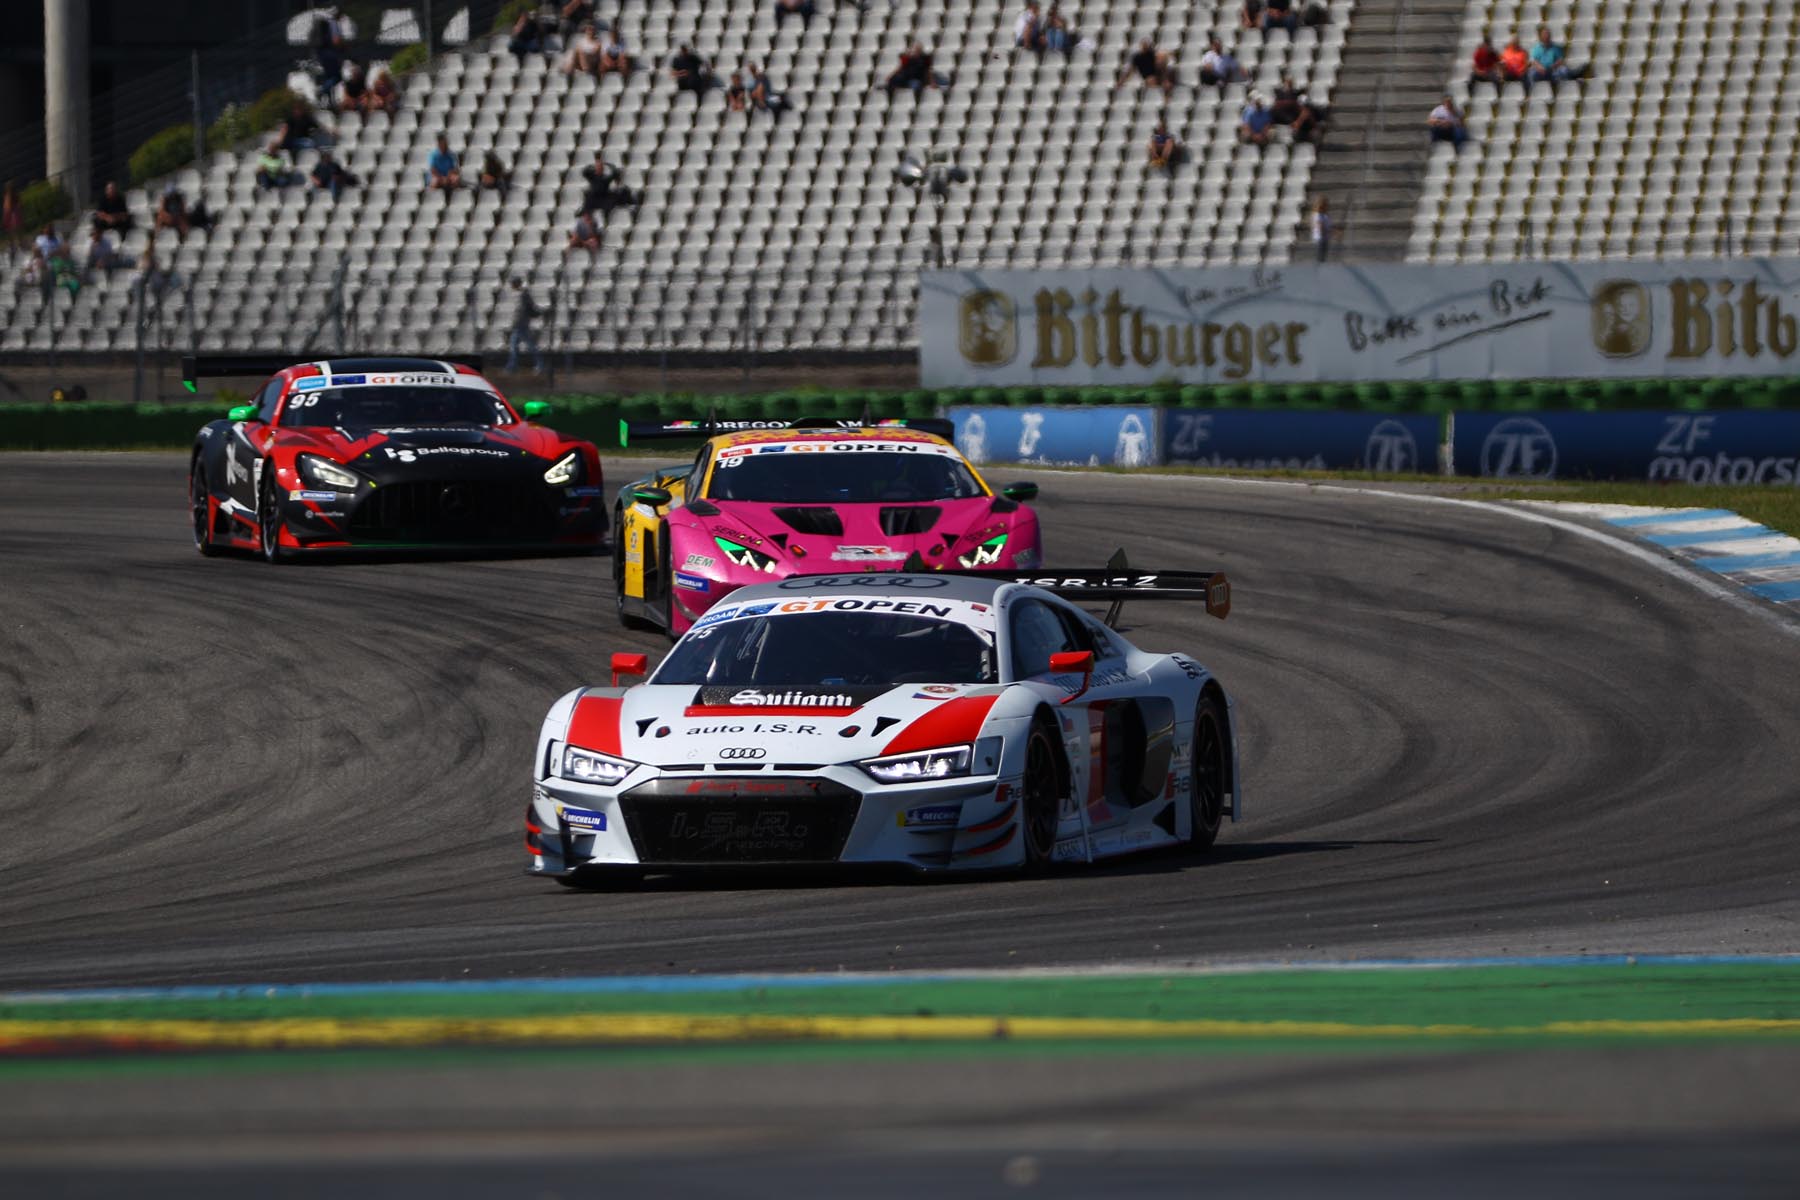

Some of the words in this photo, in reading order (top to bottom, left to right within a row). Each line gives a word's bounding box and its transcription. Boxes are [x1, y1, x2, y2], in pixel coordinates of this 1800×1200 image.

[1344, 309, 1422, 352] Bitte
[1433, 305, 1483, 332] ein
[1489, 274, 1553, 317] Bit
[1031, 284, 1309, 379] Bitburger
[289, 392, 322, 410] 95
[1172, 414, 1214, 452] ZF
[1655, 415, 1716, 453] ZF
[718, 457, 744, 469] 19
[686, 724, 744, 735] auto
[752, 723, 823, 736] I.S.R.
[567, 813, 601, 825] MICHELIN
